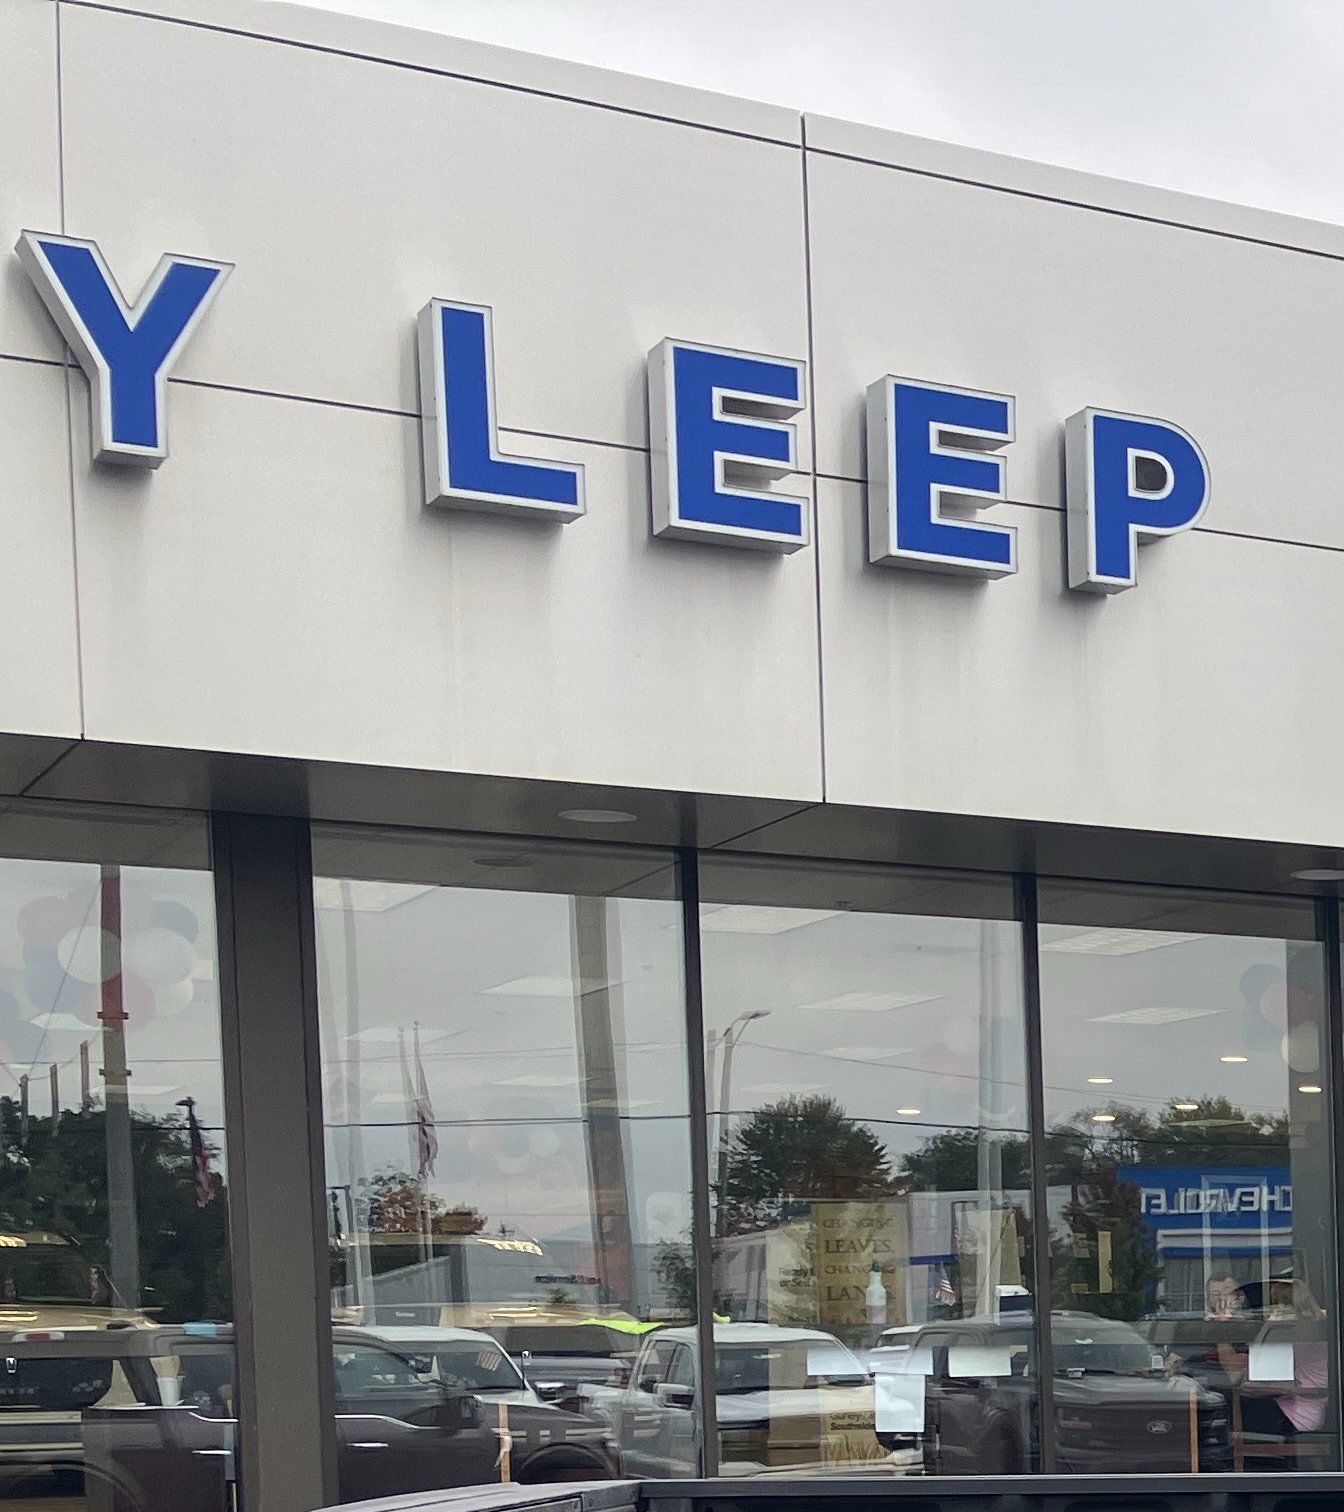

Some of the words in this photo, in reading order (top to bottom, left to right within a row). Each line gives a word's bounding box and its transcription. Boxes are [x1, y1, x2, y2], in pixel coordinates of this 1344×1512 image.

[15, 229, 236, 469] Y
[417, 297, 1212, 595] LEEP
[824, 1239, 892, 1254] LEAVES
